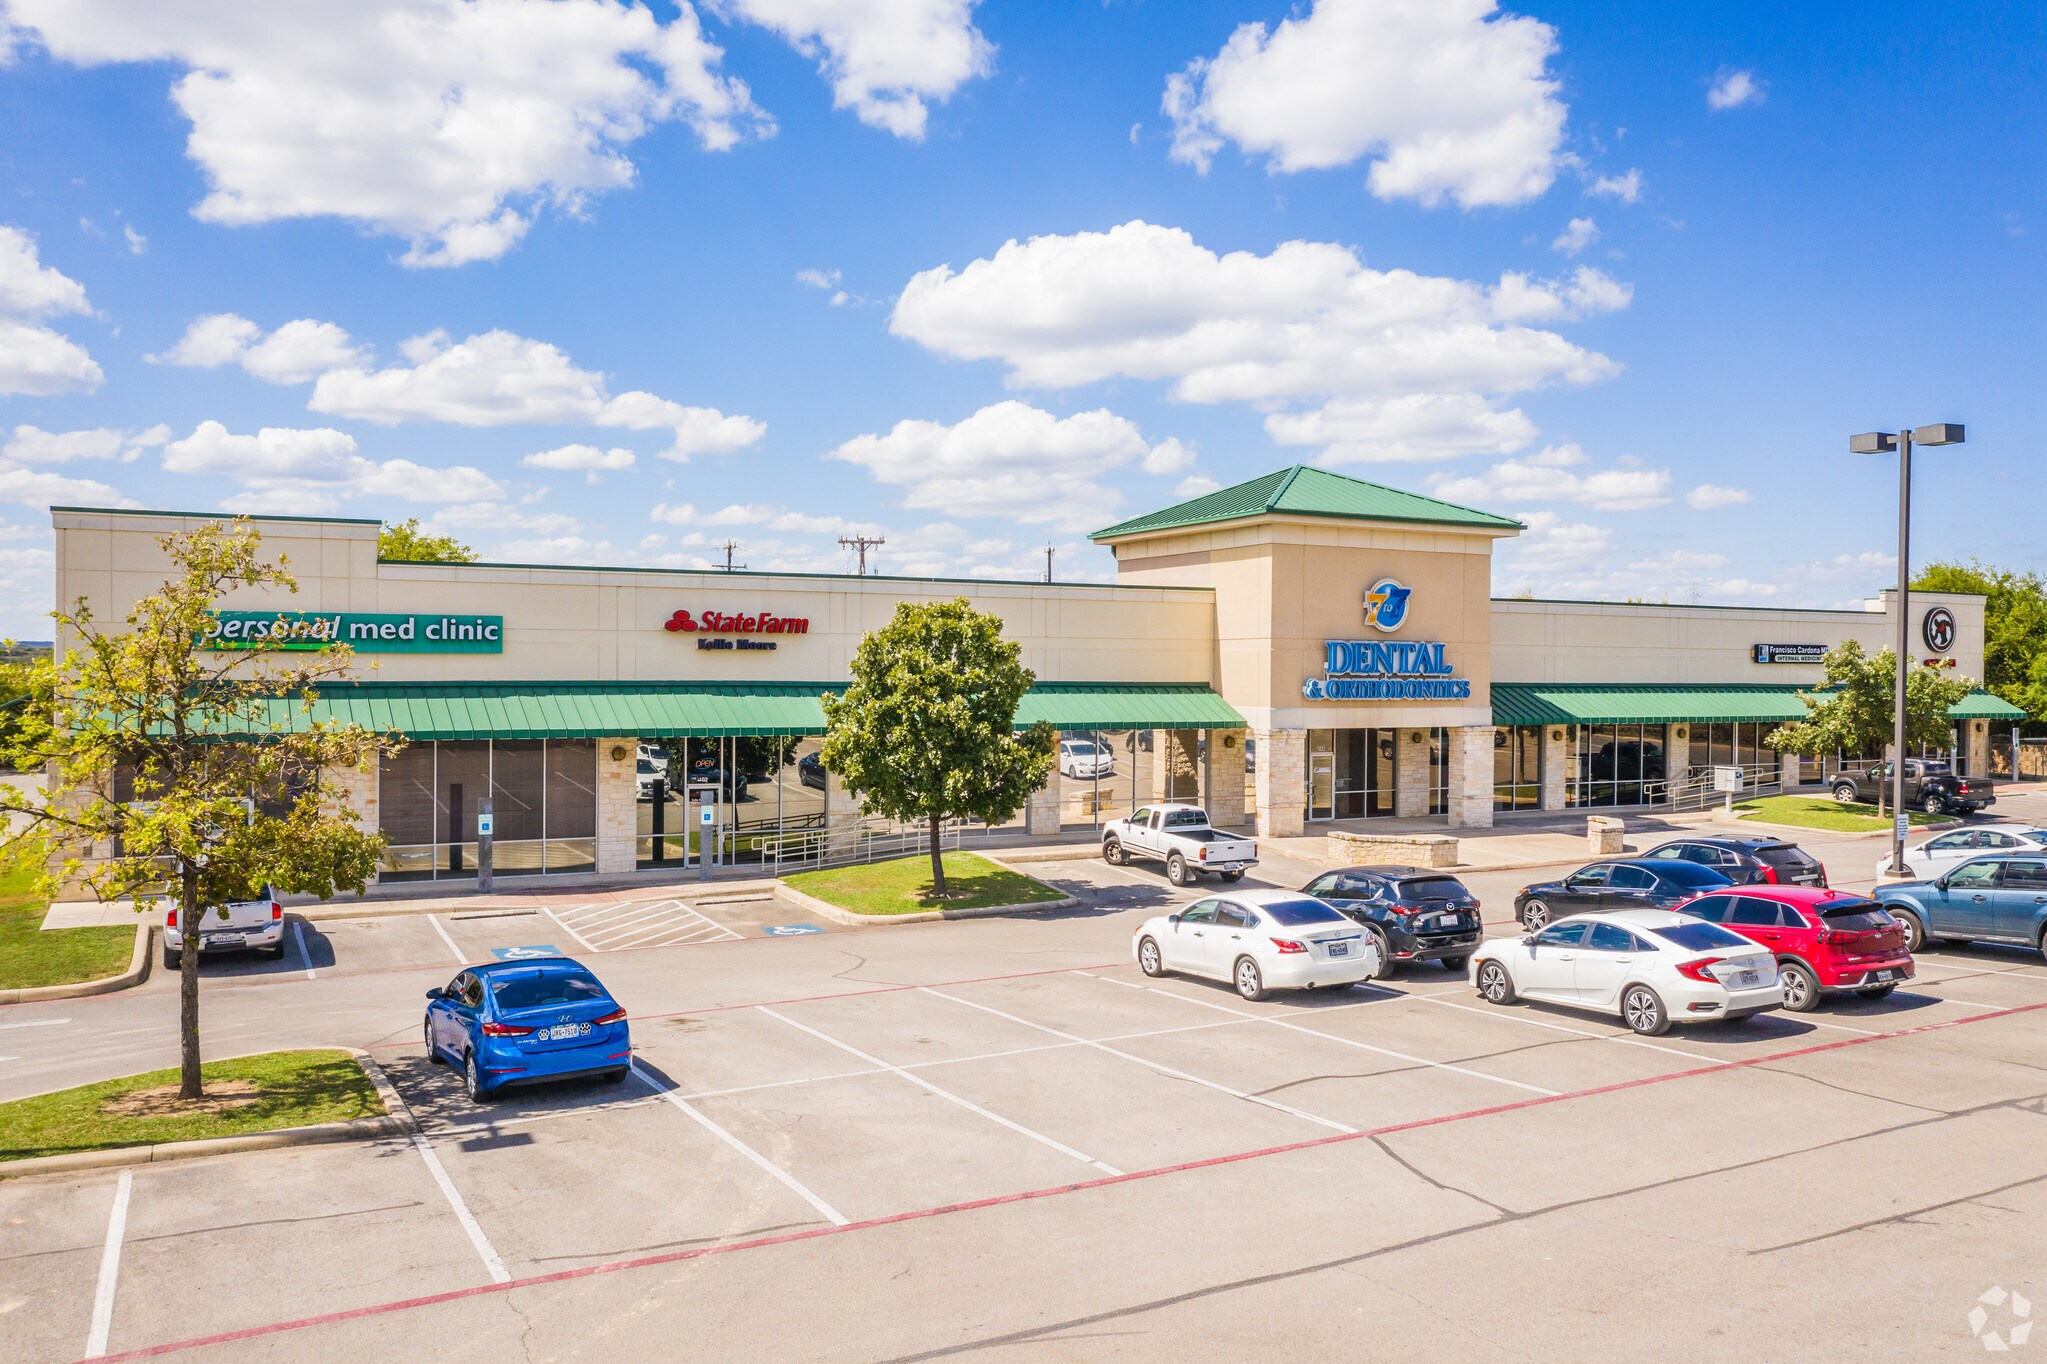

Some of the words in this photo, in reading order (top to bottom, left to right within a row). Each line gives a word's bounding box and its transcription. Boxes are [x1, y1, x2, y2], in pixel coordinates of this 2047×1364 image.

[350, 617, 415, 640] med
[425, 618, 499, 641] clinic
[697, 638, 733, 651] Kellie
[736, 638, 777, 651] Moore
[1769, 645, 1796, 654] Francisco
[1797, 646, 1820, 654] Cardona
[1325, 641, 1453, 674] DENTAL
[1304, 679, 1324, 699] &
[1326, 678, 1471, 699] ORTHODONTICS
